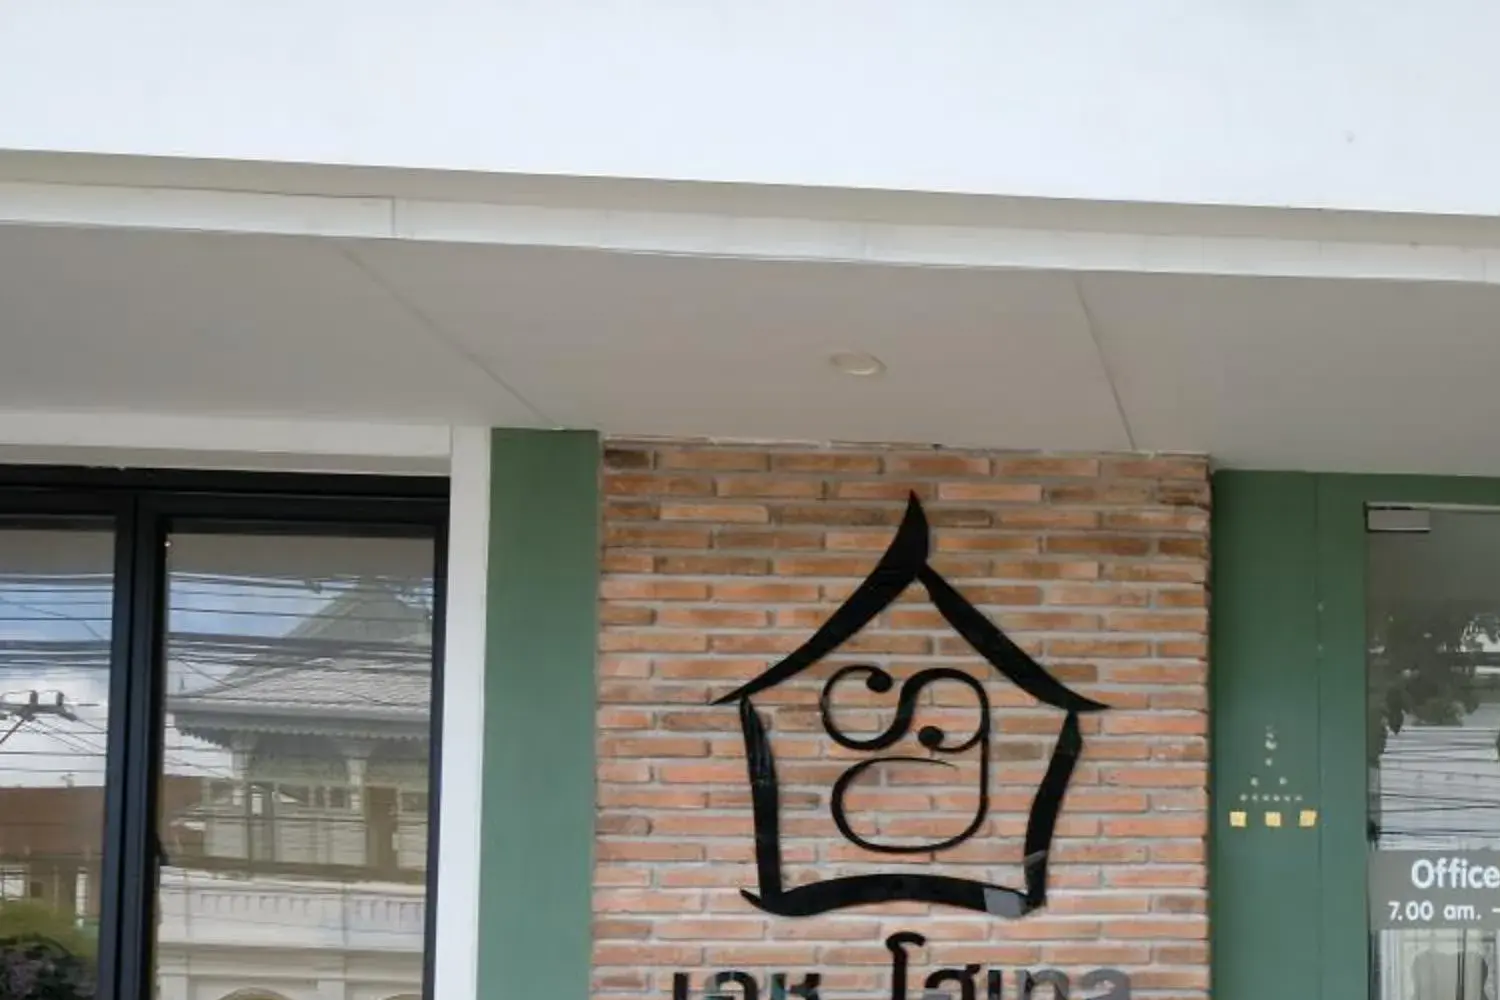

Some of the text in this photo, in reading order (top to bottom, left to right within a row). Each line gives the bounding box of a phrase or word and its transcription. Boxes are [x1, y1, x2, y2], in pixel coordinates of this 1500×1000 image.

[1410, 858, 1500, 889] Office
[1387, 900, 1433, 921] 7.00
[1443, 904, 1482, 920] am.
